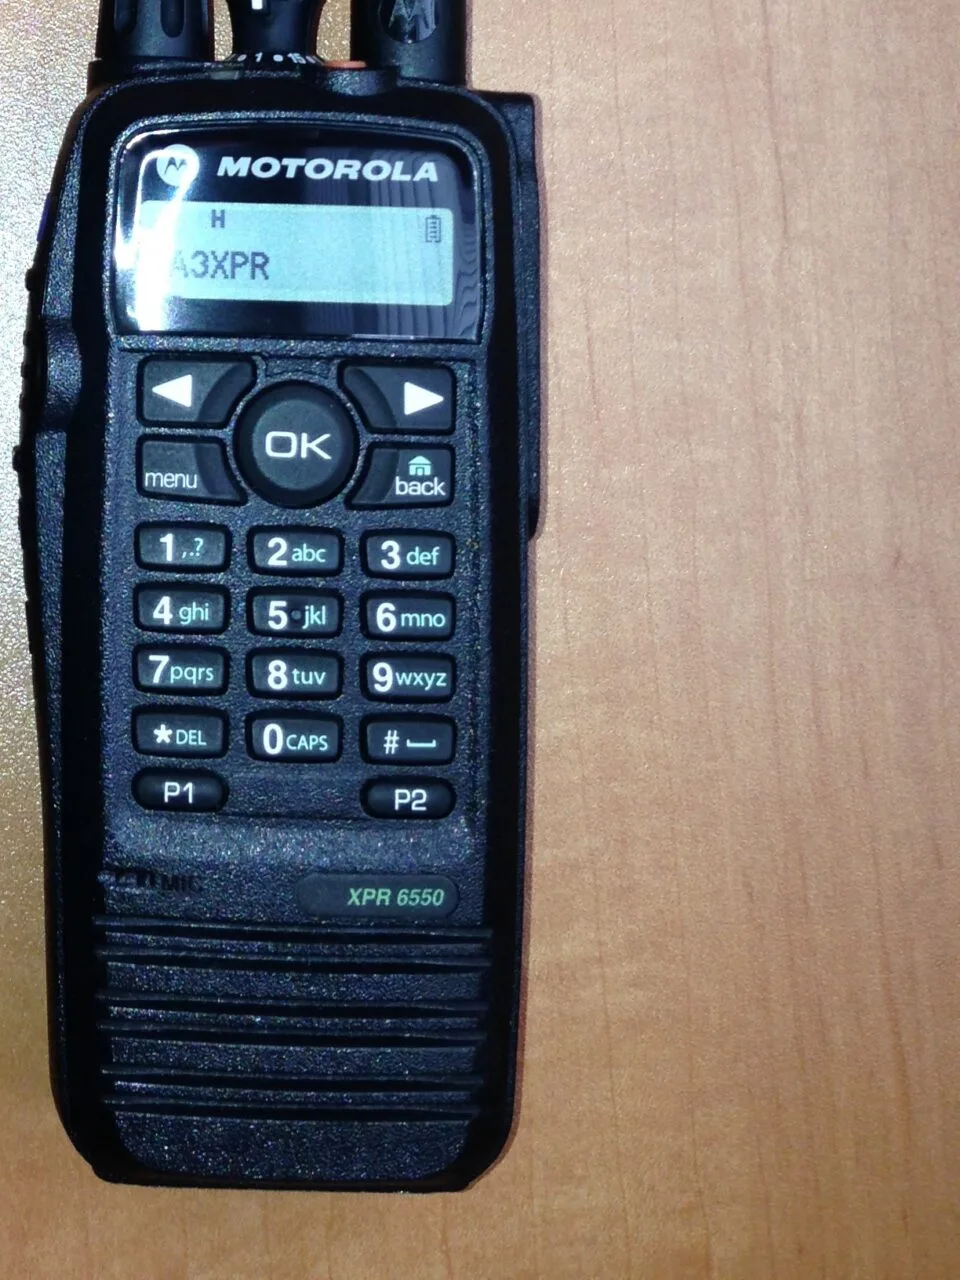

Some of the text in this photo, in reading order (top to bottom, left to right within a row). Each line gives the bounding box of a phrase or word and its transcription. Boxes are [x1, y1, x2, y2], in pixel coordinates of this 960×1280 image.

[217, 156, 439, 182] MOTOROLA
[211, 209, 225, 228] H
[265, 431, 332, 460] OK
[145, 472, 197, 489] menu
[395, 477, 446, 496] back
[267, 537, 326, 567] 2 abc
[380, 540, 440, 570] 3 def
[152, 596, 210, 627] 4 ghi
[267, 600, 327, 630] 5 jkl
[375, 602, 446, 632] 6 mno
[148, 655, 214, 684] 7 pqrs
[267, 659, 326, 690] 8 tuv
[372, 662, 448, 692] 9 wxyz
[176, 729, 207, 746] DEL
[286, 734, 328, 751] CAPS
[163, 782, 195, 803] P1
[394, 789, 428, 811] P2
[347, 888, 445, 907] XPR 6550
